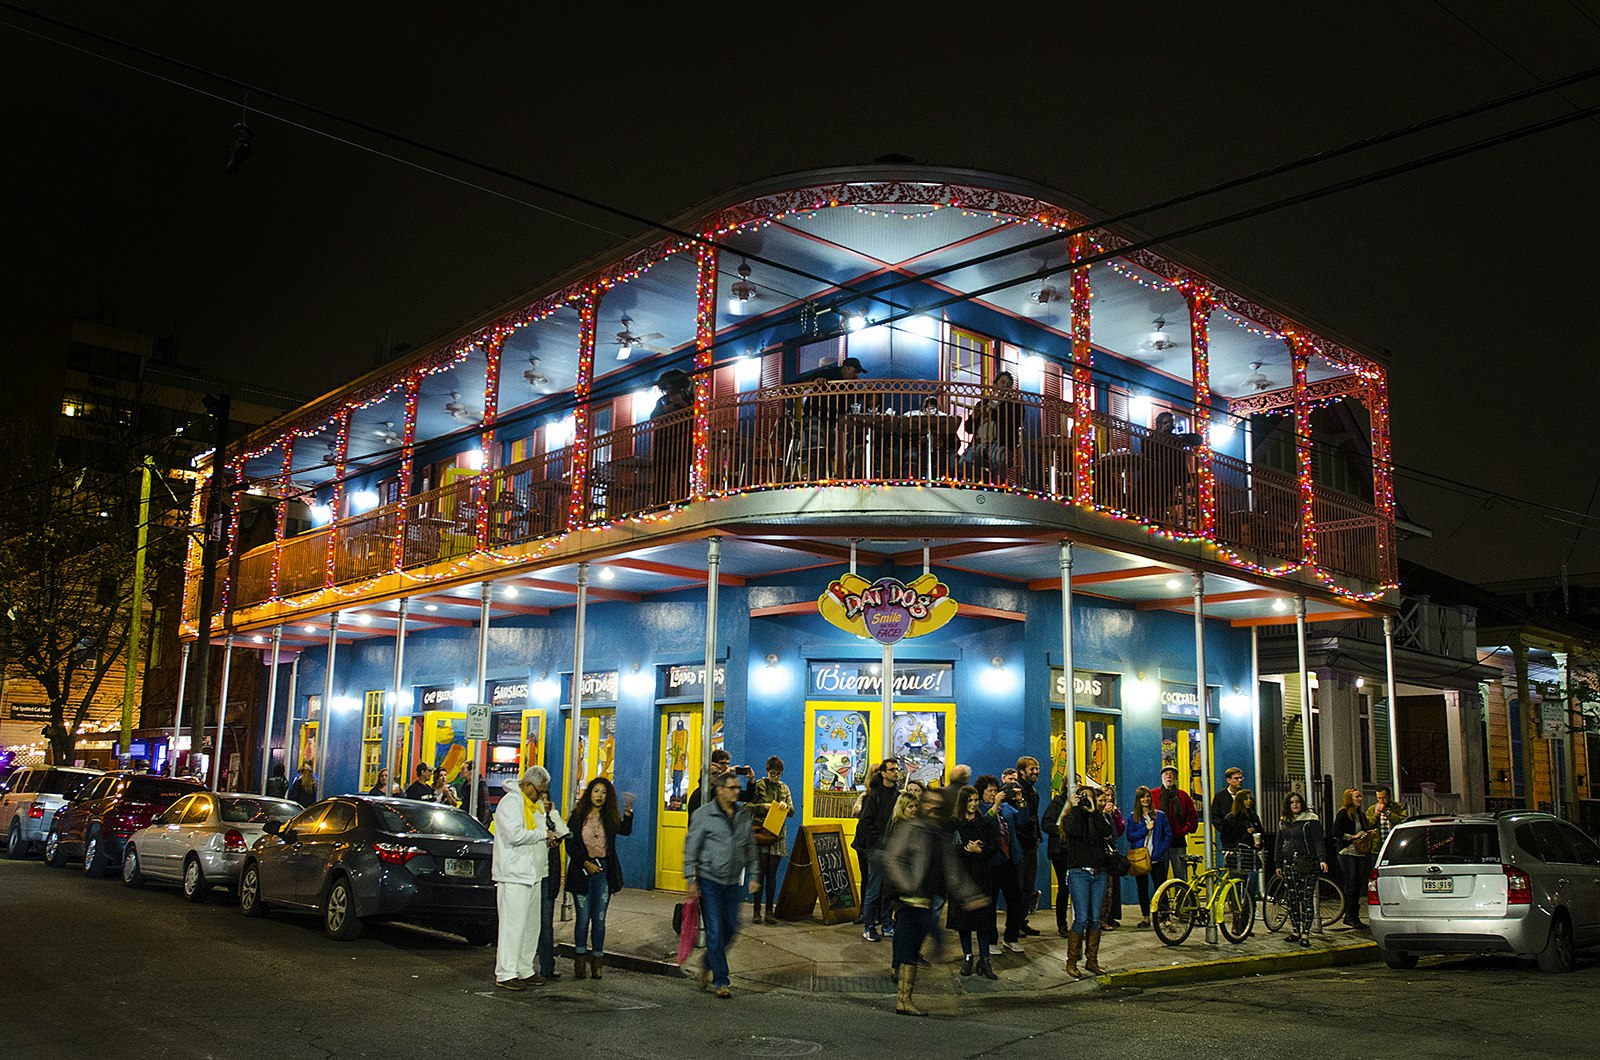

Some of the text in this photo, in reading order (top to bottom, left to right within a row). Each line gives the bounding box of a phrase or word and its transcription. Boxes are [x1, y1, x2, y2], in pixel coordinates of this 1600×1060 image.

[845, 583, 931, 618] DAT DOG
[871, 611, 902, 625] Smile
[876, 628, 902, 637] FACE!
[670, 668, 725, 688] LOADED FES
[1056, 676, 1102, 696] SDAS
[493, 684, 529, 701] SAUSAGES
[1160, 691, 1200, 705] COCKTAIL
